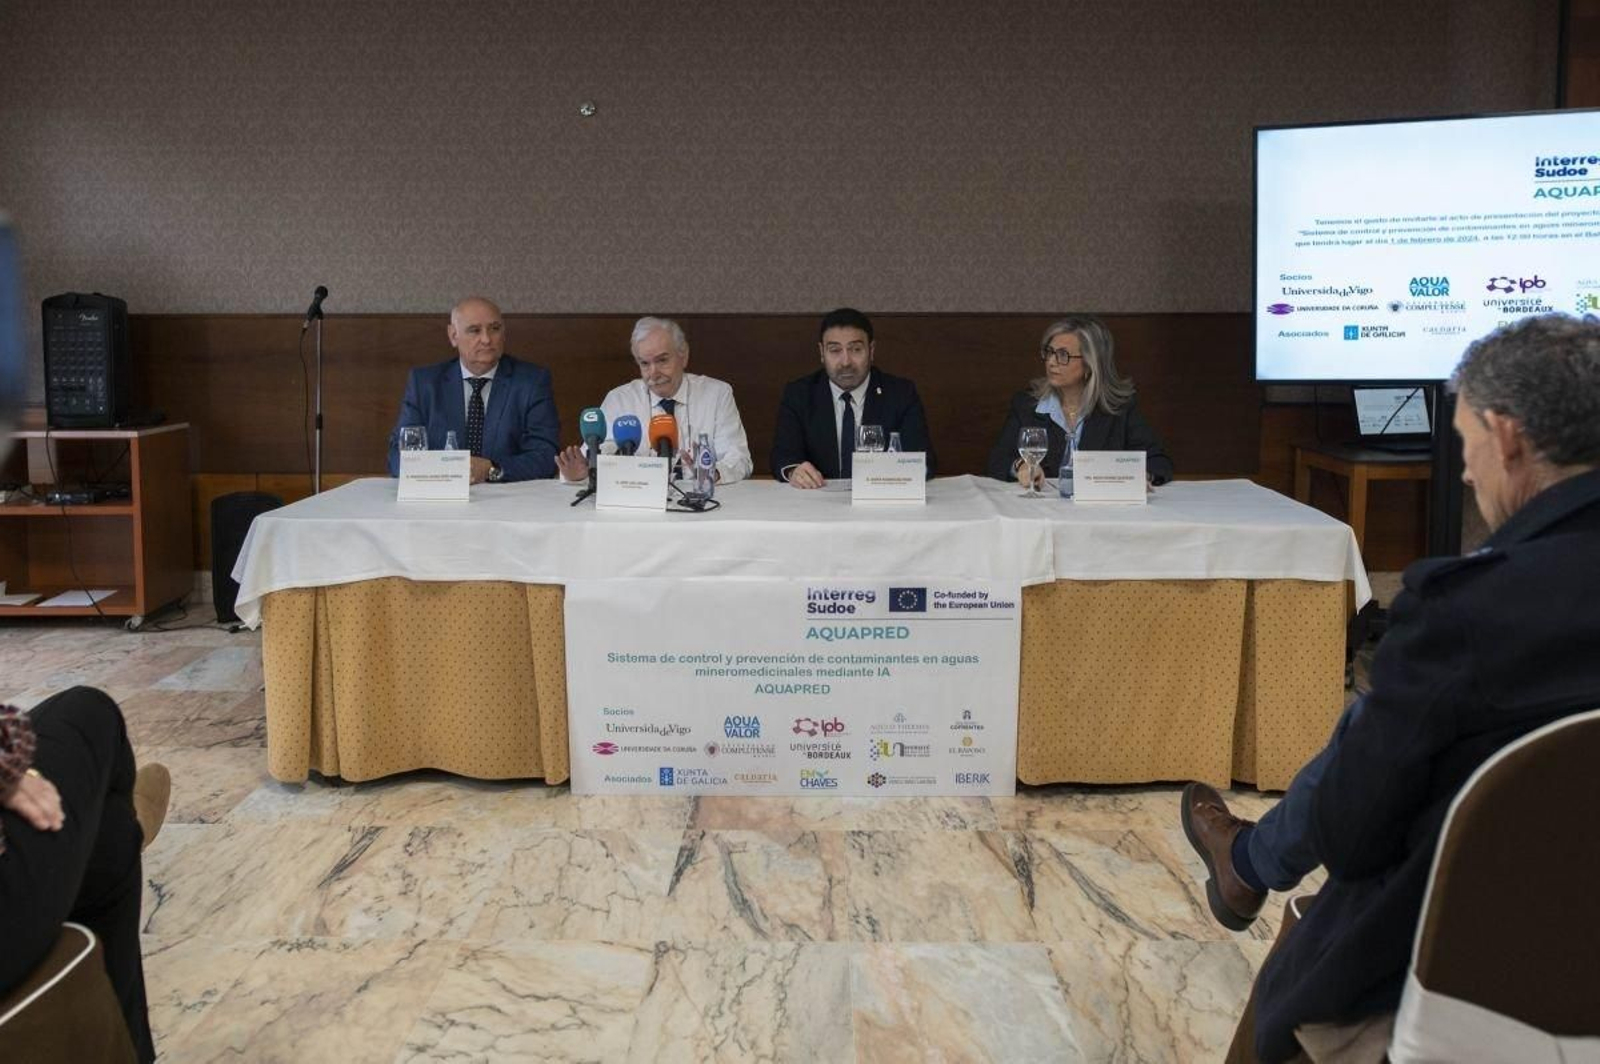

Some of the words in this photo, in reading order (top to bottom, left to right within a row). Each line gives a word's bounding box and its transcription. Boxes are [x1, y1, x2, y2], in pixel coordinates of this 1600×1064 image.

[1535, 155, 1600, 167] Interre
[1535, 166, 1588, 178] Sudoe
[1279, 273, 1313, 281] Socios
[1409, 276, 1450, 287] AQUA
[1410, 286, 1450, 297] VALOR
[1278, 329, 1330, 338] Asociados
[807, 588, 876, 603] Interreg
[934, 590, 977, 600] Co-funded
[978, 591, 988, 600] by
[807, 602, 856, 614] Sudoe
[934, 600, 946, 610] the
[948, 600, 988, 610] European
[989, 600, 1015, 609] Union
[805, 625, 910, 642] AQUAPRED
[607, 652, 656, 663] Sistema
[659, 653, 675, 663] de
[678, 653, 722, 663] control
[726, 655, 732, 666] y
[736, 653, 805, 666] prevención
[808, 653, 824, 664] de
[827, 654, 919, 664] contaminantes
[922, 655, 938, 663] en
[941, 655, 979, 666] aguas
[695, 667, 813, 677] mineromedicinales
[816, 667, 874, 677] mediante
[877, 667, 890, 677] IA
[754, 683, 831, 696] AQUAPRED
[603, 708, 634, 716] Socios
[724, 716, 760, 727] AQUA
[724, 727, 760, 738] VALOR
[677, 768, 708, 776] XUNTA
[604, 774, 652, 784] Asociados
[676, 777, 689, 785] DE
[691, 777, 728, 786] GALICIA
[800, 778, 838, 788] CHAVES
[955, 773, 990, 785] IBERIK
